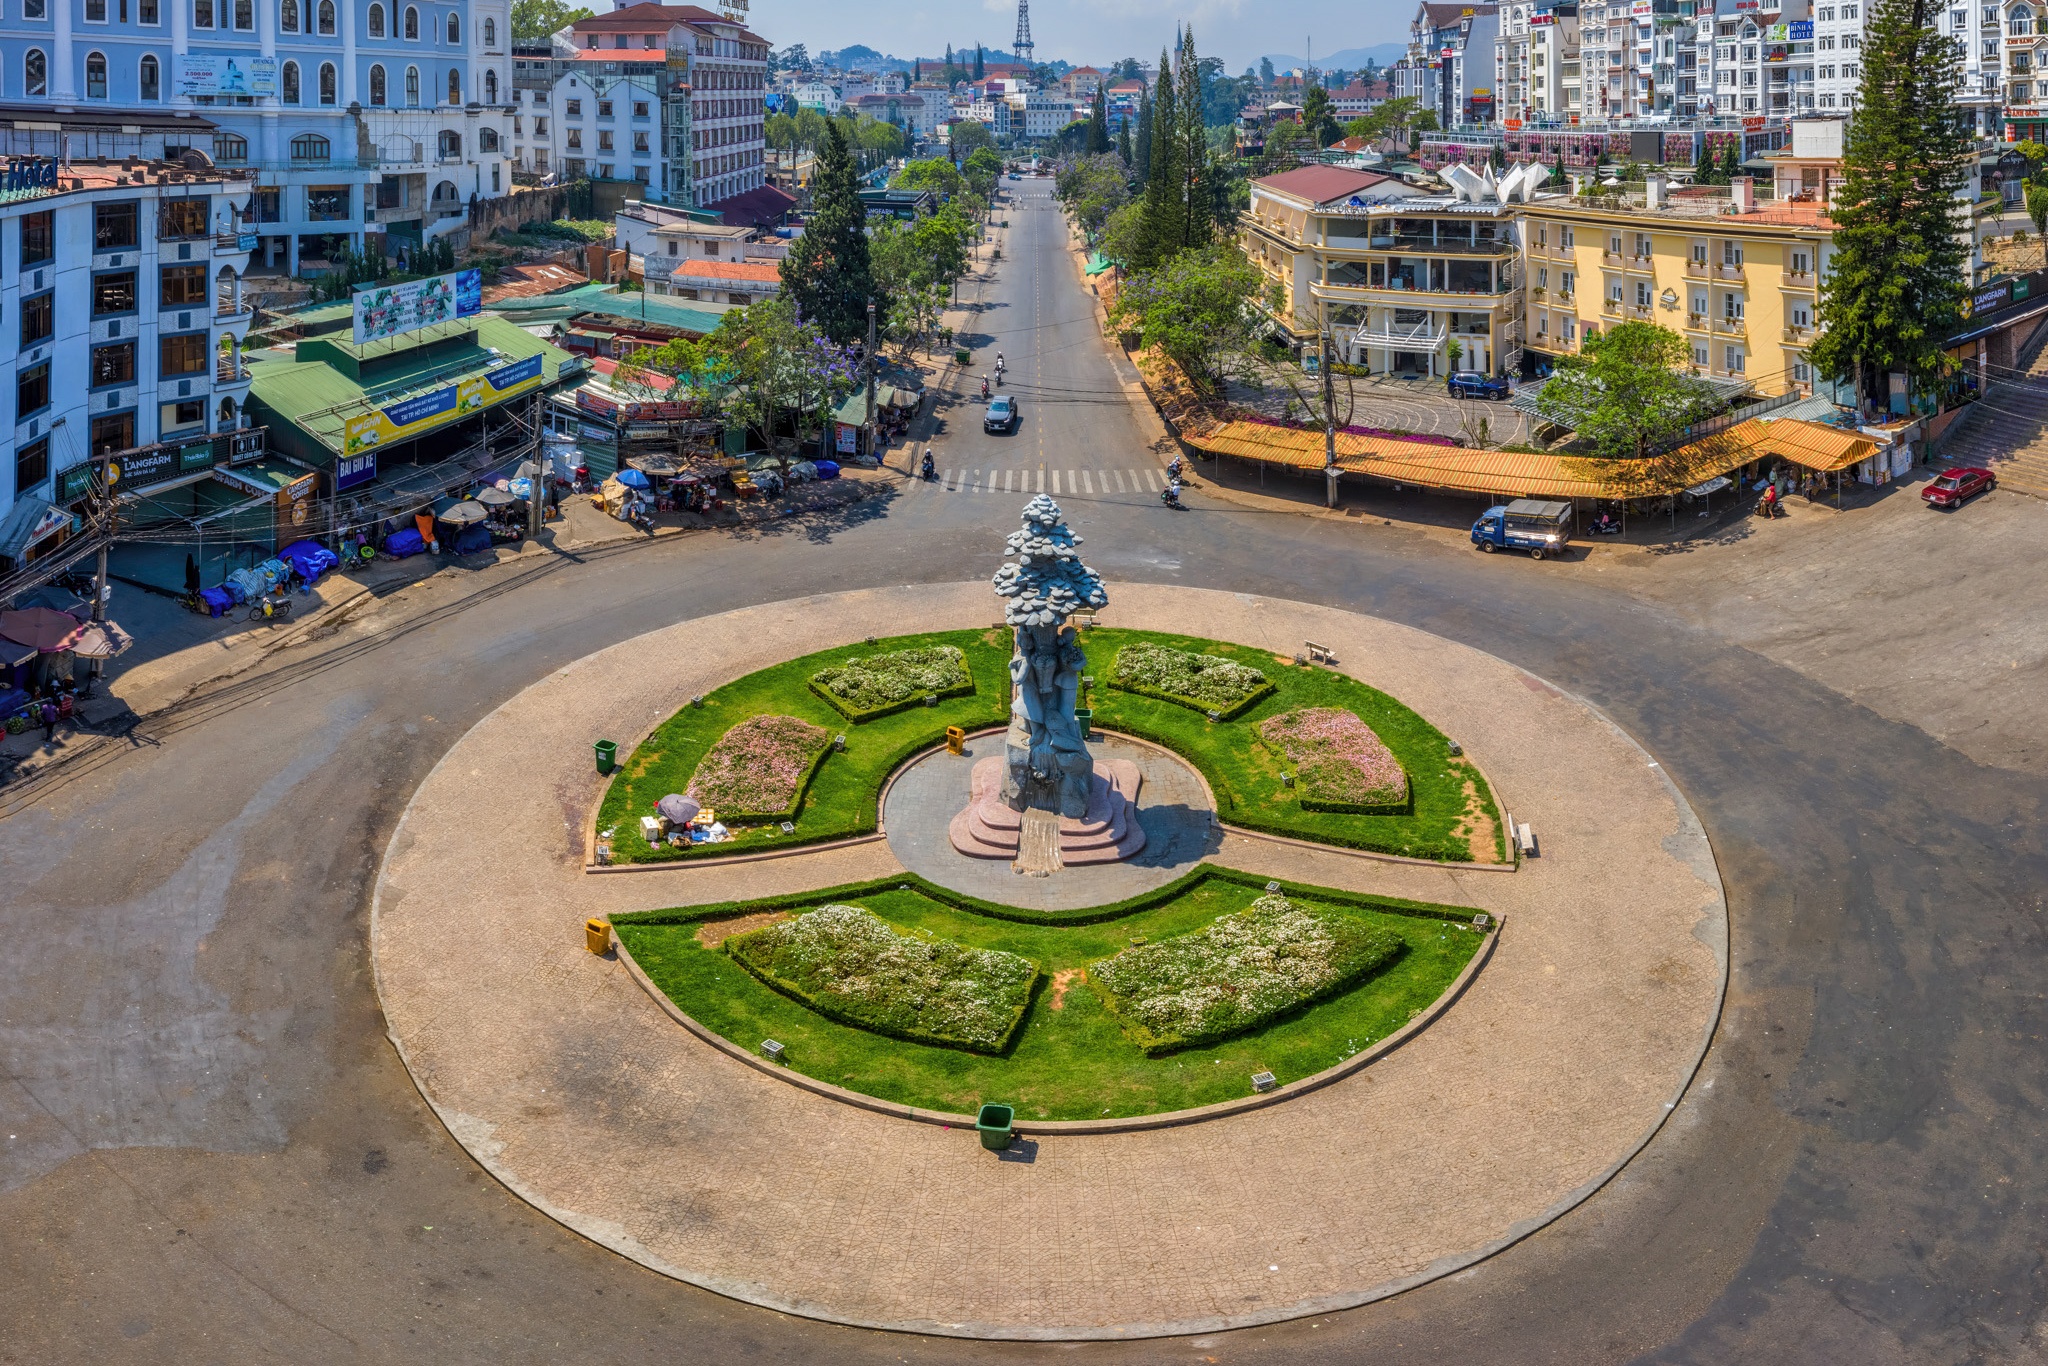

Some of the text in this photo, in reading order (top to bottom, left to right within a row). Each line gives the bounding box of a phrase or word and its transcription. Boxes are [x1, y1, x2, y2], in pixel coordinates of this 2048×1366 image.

[8, 155, 59, 192] Hotel
[1975, 287, 2006, 305] L'ANGFARM
[428, 403, 440, 412] MINH
[362, 415, 382, 429] GHN
[124, 454, 172, 471] L'ANGFARM
[213, 472, 242, 490] GFARM
[287, 477, 314, 495] L'ANGFARM
[291, 487, 309, 500] COFFEE
